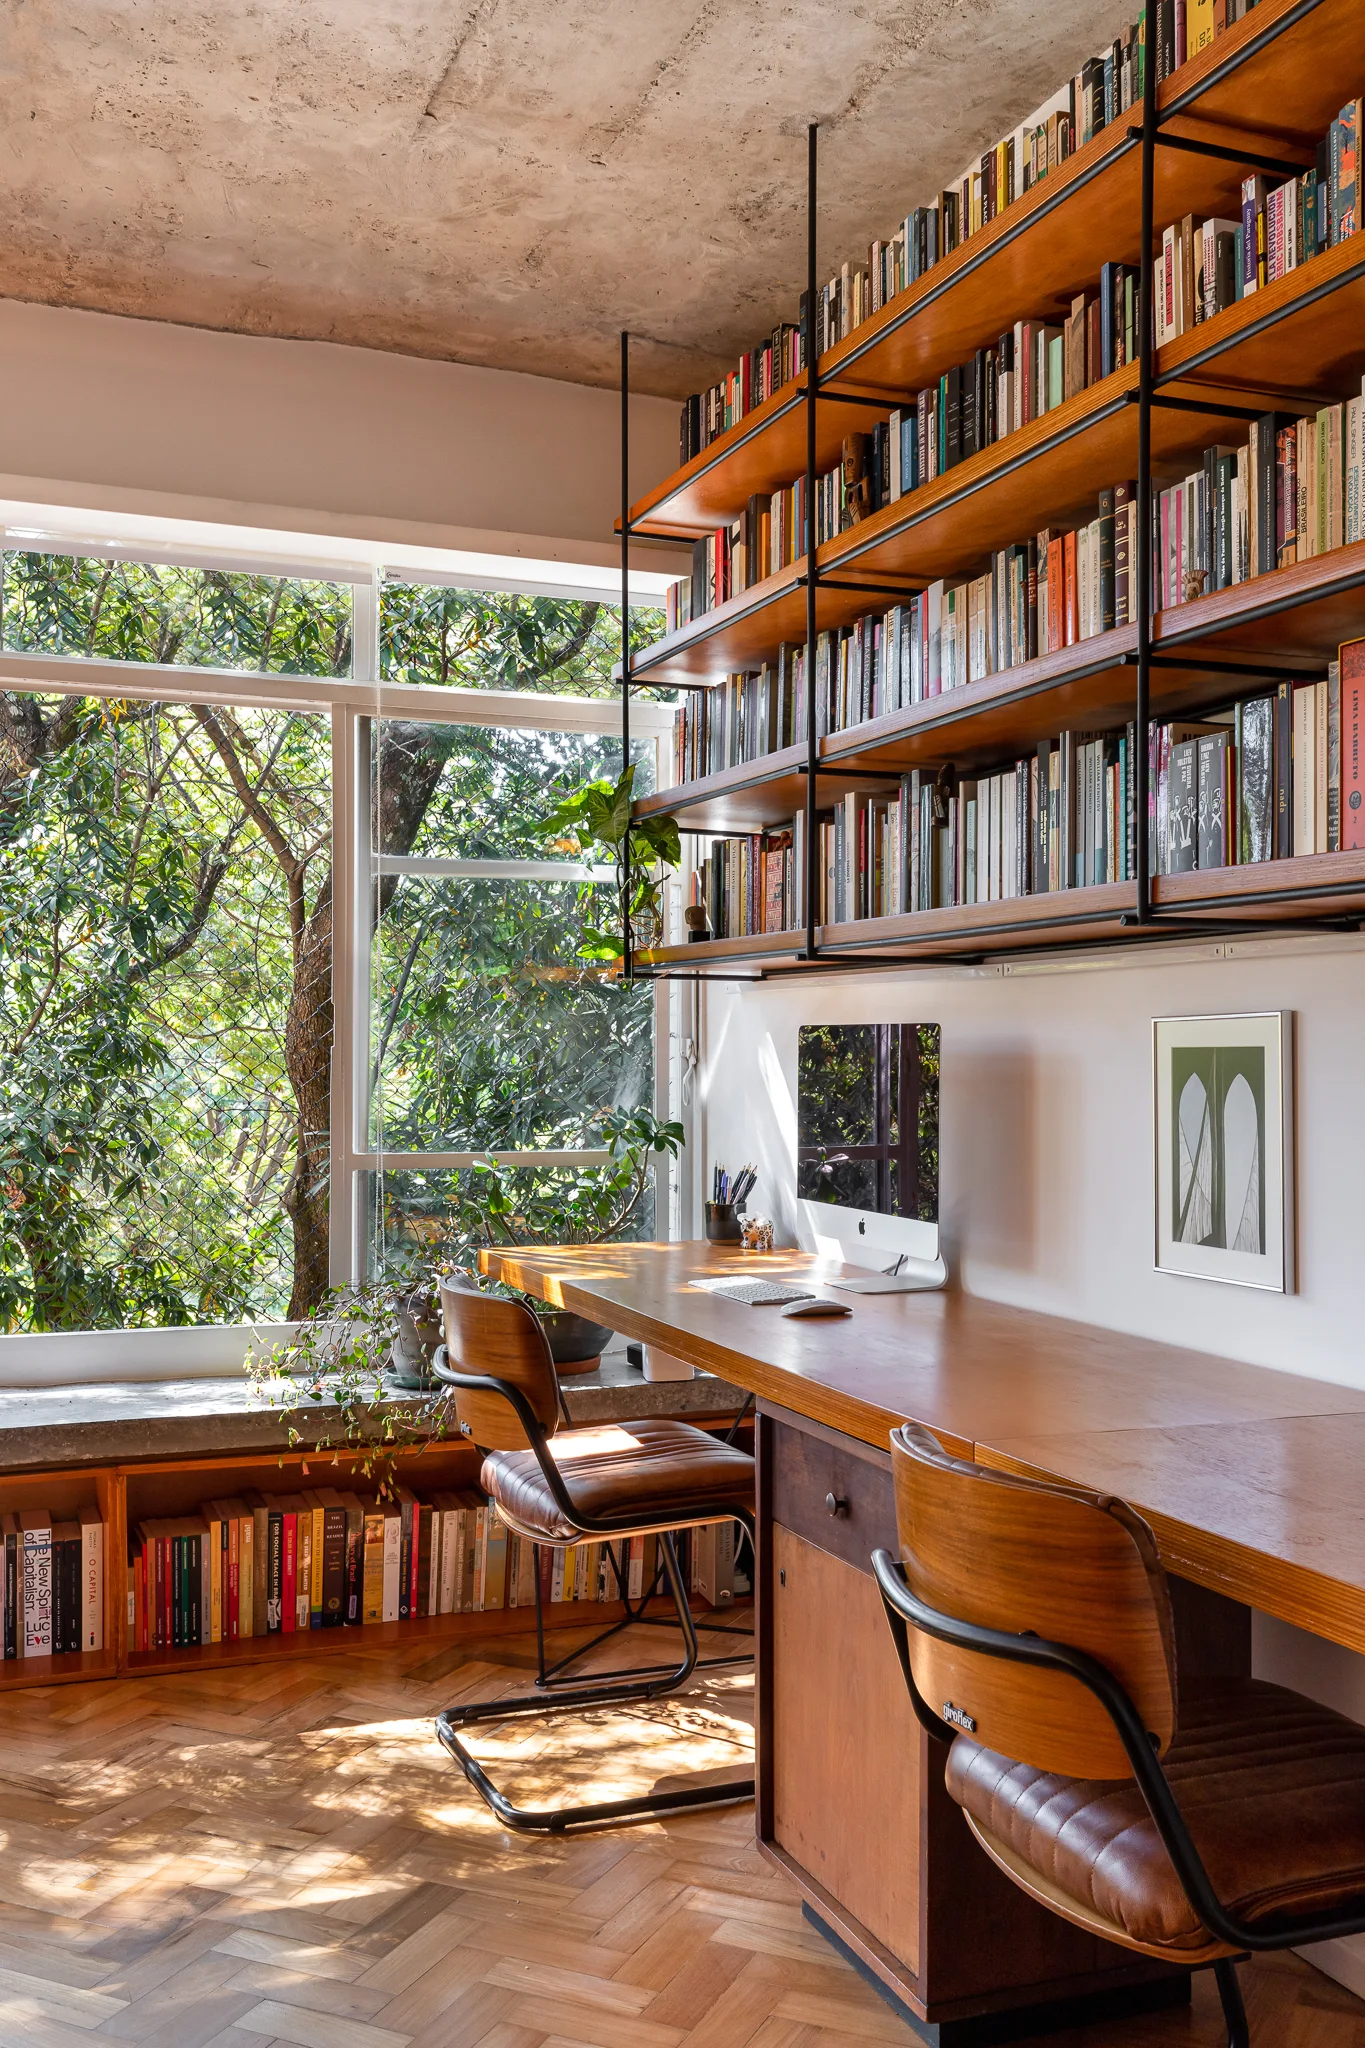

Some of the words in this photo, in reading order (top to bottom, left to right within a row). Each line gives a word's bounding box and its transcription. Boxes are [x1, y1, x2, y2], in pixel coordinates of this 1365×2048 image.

[1276, 189, 1284, 251] HOBSBAWM
[1269, 261, 1276, 275] LA
[1276, 253, 1284, 277] ERIC
[1102, 498, 1108, 508] 6
[1217, 738, 1223, 747] 2
[1279, 788, 1287, 813] nada
[1353, 816, 1358, 824] 2
[25, 1532, 38, 1545] of
[38, 1529, 51, 1555] The
[316, 1549, 321, 1557] DE
[457, 1536, 465, 1562] prestes
[89, 1558, 97, 1566] O
[38, 1557, 51, 1588] New
[349, 1564, 357, 1582] Brazil
[89, 1569, 97, 1605] CAPITAL
[273, 1578, 279, 1586] IN
[26, 1621, 50, 1633] Luc
[26, 1634, 50, 1647] Eve
[943, 1703, 974, 1732] giroflex
